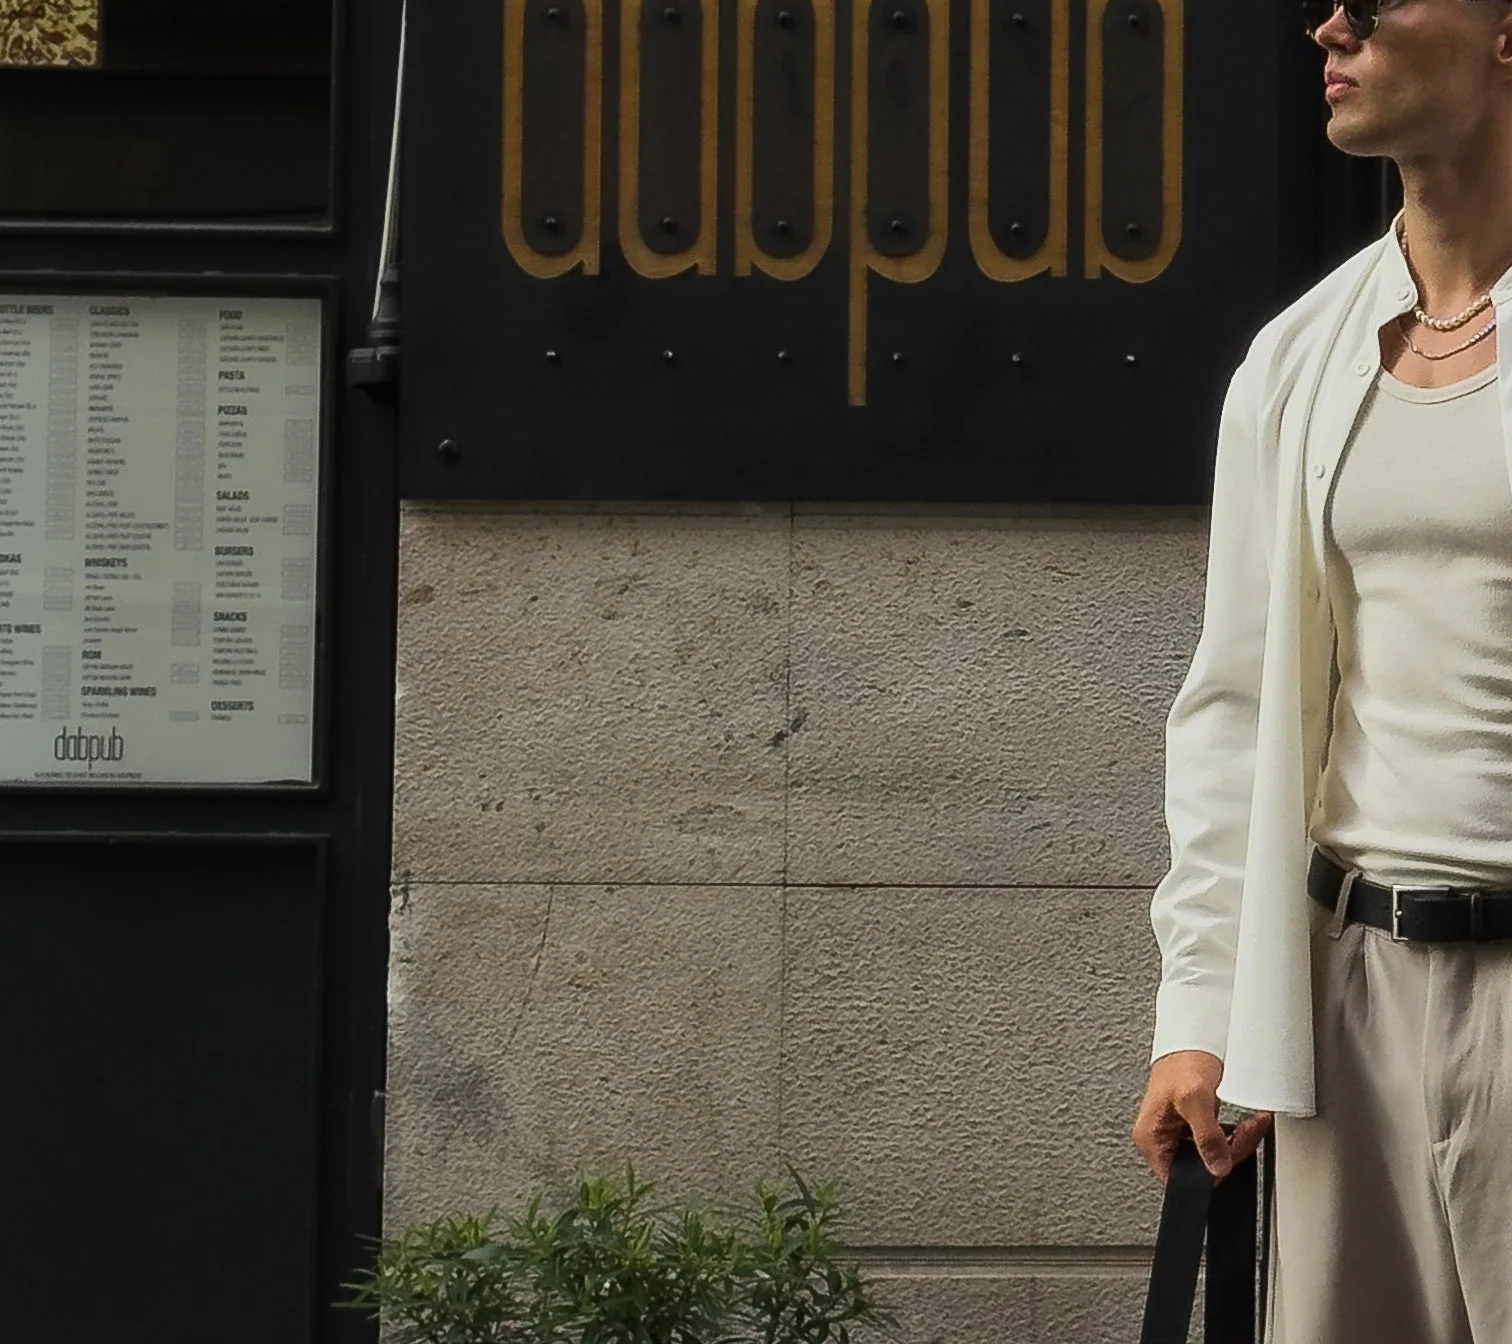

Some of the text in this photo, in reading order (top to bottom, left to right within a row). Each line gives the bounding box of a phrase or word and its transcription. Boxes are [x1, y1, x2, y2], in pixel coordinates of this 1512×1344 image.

[88, 304, 130, 316] CLASSICS
[218, 309, 243, 320] FOOD
[218, 370, 245, 381] PASTA
[217, 404, 248, 416] PIZZAS
[215, 490, 250, 501] SALADS
[214, 546, 254, 556] BURGERS
[212, 611, 248, 622] SNACKS
[81, 686, 157, 697] SPARKLING WINES
[210, 700, 255, 711] DESSERTS
[54, 725, 125, 771] dabpub
